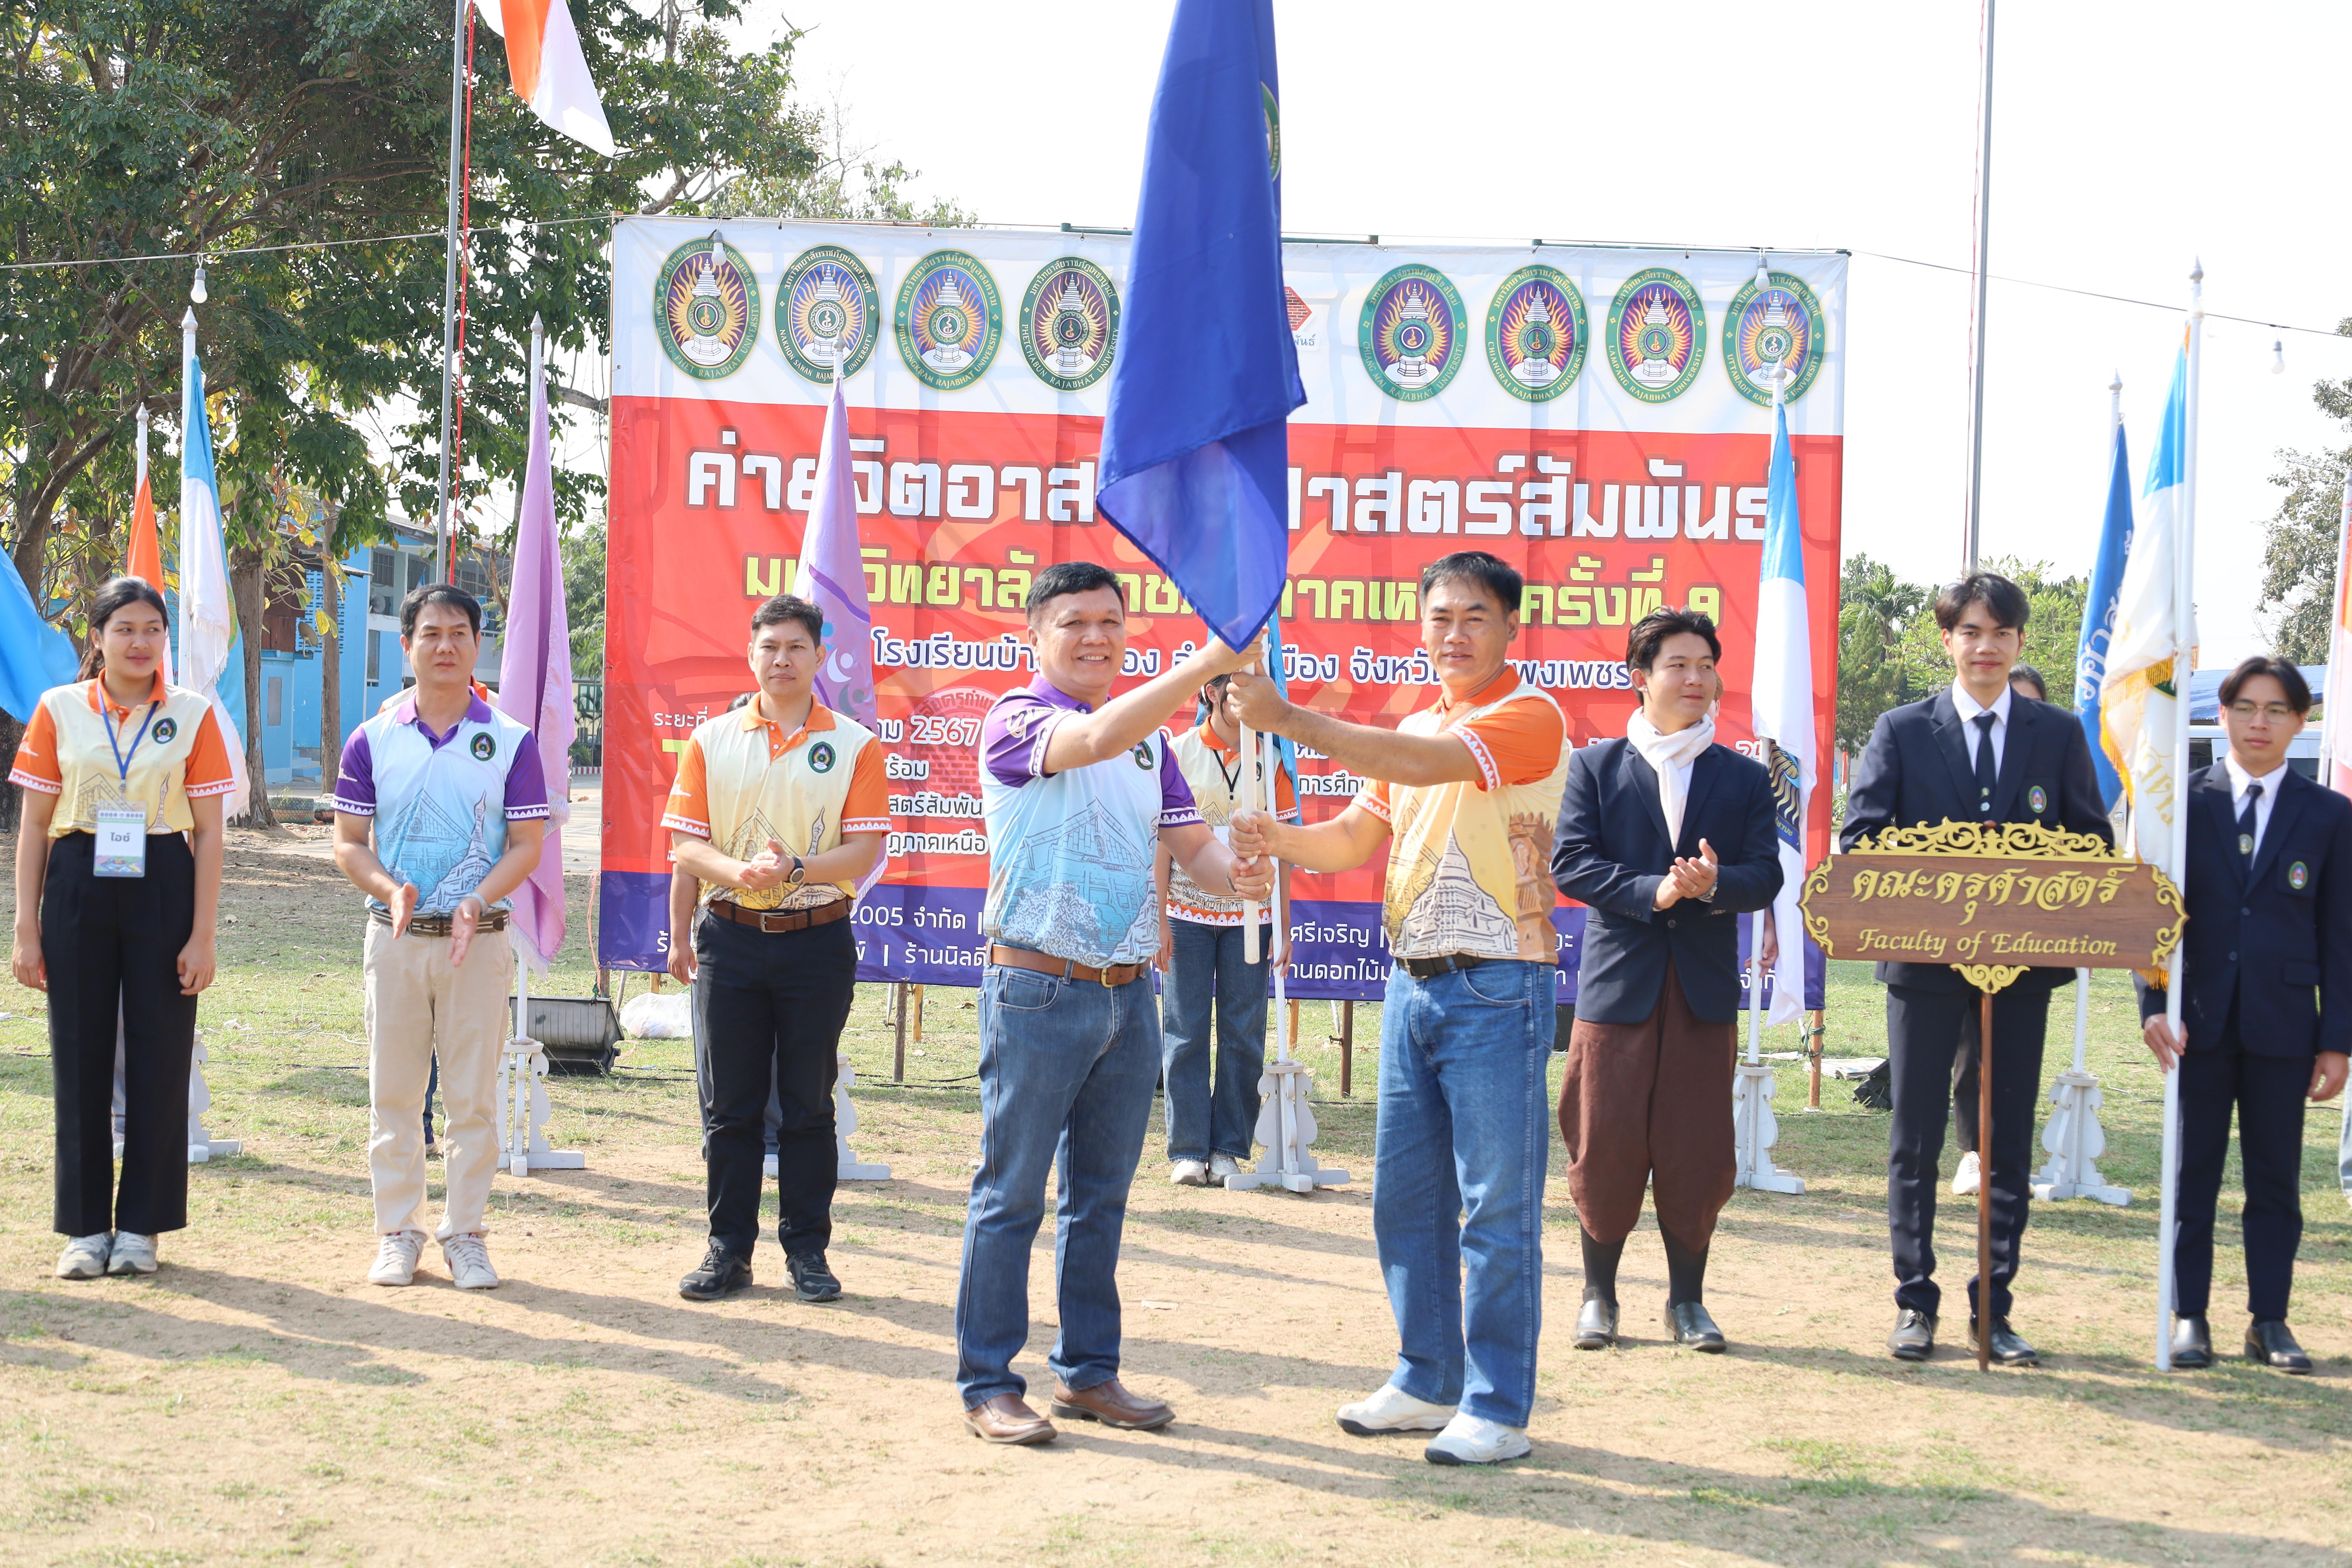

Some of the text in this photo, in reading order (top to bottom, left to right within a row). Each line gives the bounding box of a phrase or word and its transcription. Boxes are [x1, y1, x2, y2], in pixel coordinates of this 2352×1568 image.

[657, 296, 759, 378] KAMPHAENG PHET RAJABHAT UNIVERSITY
[780, 329, 873, 381] NAKHON SAWAN RAJAB UNIVERSITY
[898, 324, 998, 388] PIBULSONGKRAM RAJABHAT UNIVERSITY
[1022, 324, 1119, 388] PHETCHABUN RAJABHAT UNIVERSITY
[1363, 341, 1464, 400] CHIANG MAI RAJABHAT UNIVERSITY
[1488, 341, 1585, 400] CHIANGRAI RAJABHAT UNIVERSITY
[1609, 345, 1703, 400] LAMPANG RAJABHAT UNIVERSITY
[1727, 354, 1753, 395] UTTARADIT
[1791, 355, 1819, 397] UNIVERSITY
[912, 717, 980, 744] 2567
[885, 756, 926, 777] ร้อม
[914, 906, 966, 929] จำกัด
[1851, 865, 2138, 925] คณะครุศาสตร์
[1856, 929, 2117, 960] Faculty of Education
